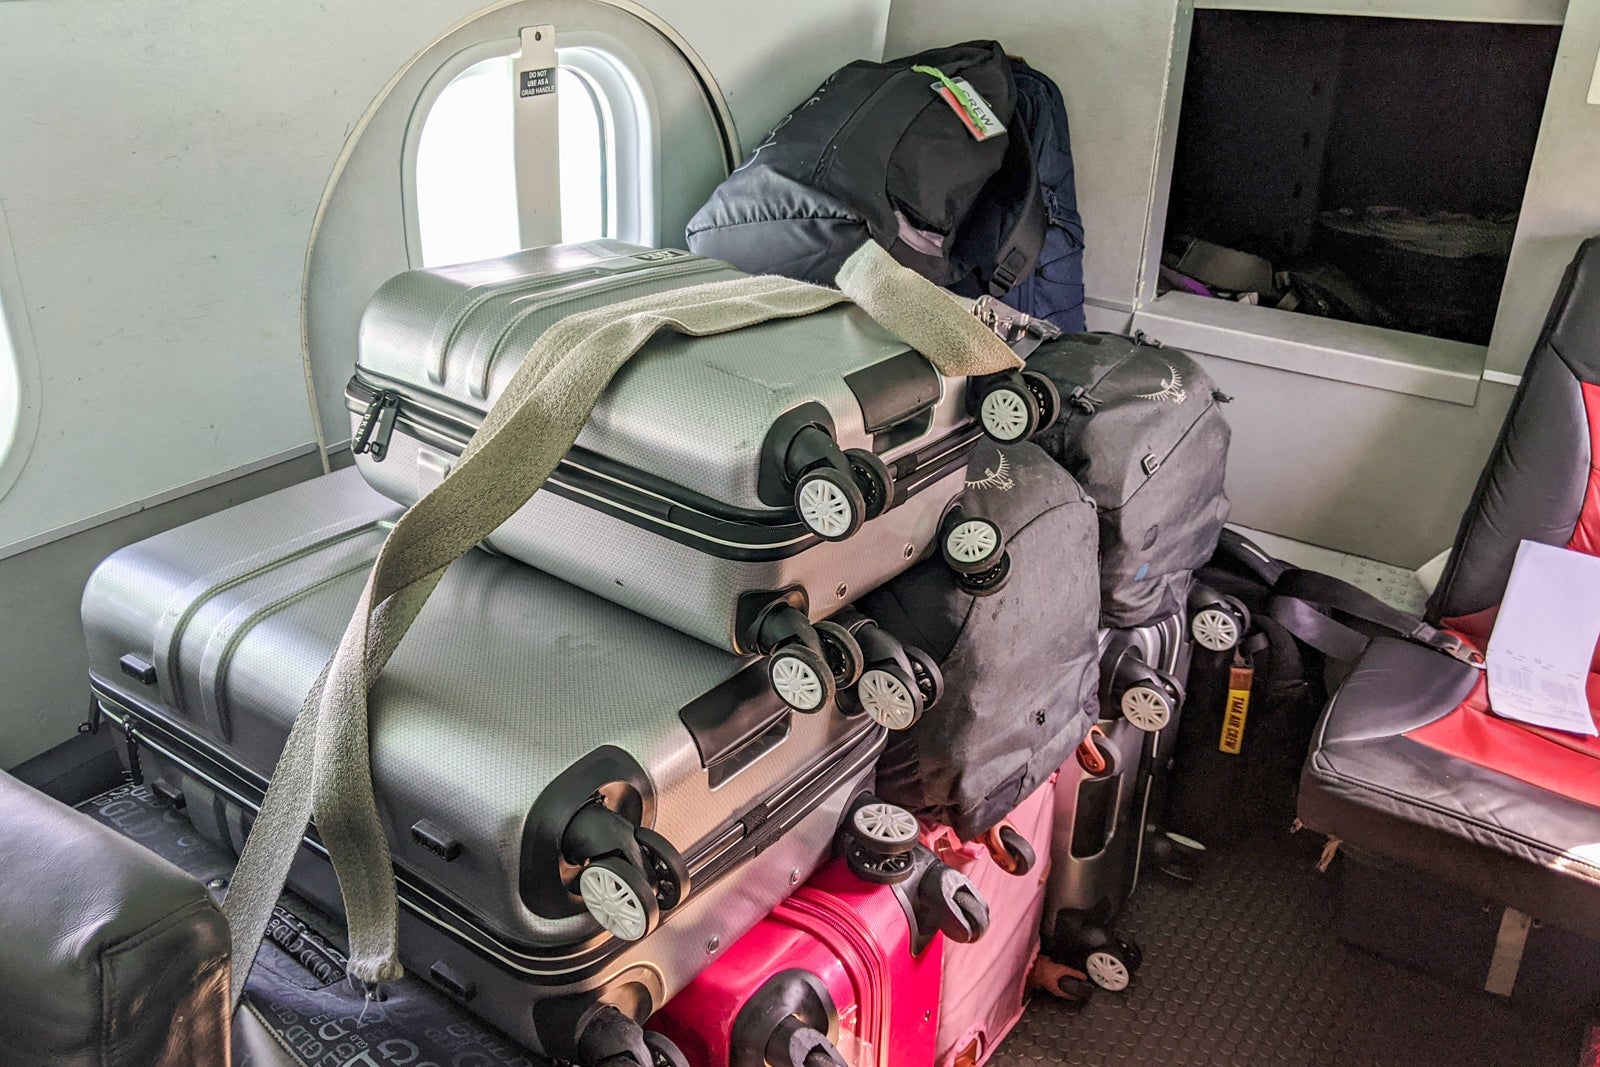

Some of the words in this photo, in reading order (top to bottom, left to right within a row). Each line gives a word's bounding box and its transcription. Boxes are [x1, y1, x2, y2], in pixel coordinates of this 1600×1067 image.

[521, 88, 535, 96] GRAB
[535, 85, 555, 93] HANDLE
[355, 413, 371, 442] DKNY
[1231, 696, 1245, 714] TMA
[1228, 714, 1242, 728] AIR
[1224, 728, 1239, 750] CREW
[285, 1025, 323, 1059] GLD
